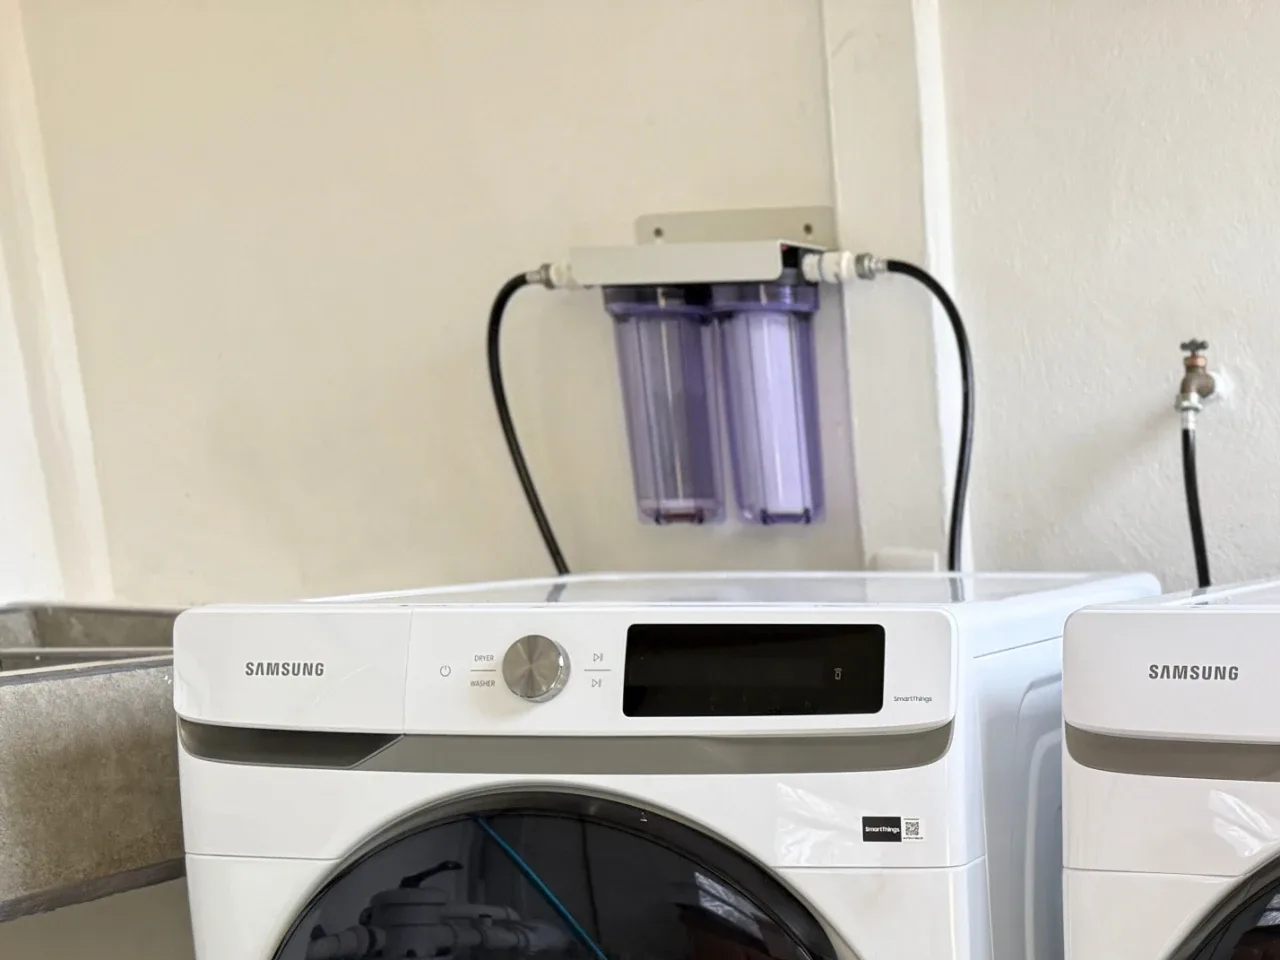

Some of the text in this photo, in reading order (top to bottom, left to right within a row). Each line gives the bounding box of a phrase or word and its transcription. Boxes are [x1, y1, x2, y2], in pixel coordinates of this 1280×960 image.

[474, 654, 495, 662] DRYER
[245, 661, 325, 677] SAMSUNG
[1148, 664, 1239, 681] SAMSUNG
[470, 680, 496, 688] WASHER
[893, 696, 933, 704] SmartThings
[865, 826, 900, 834] SmartThings
